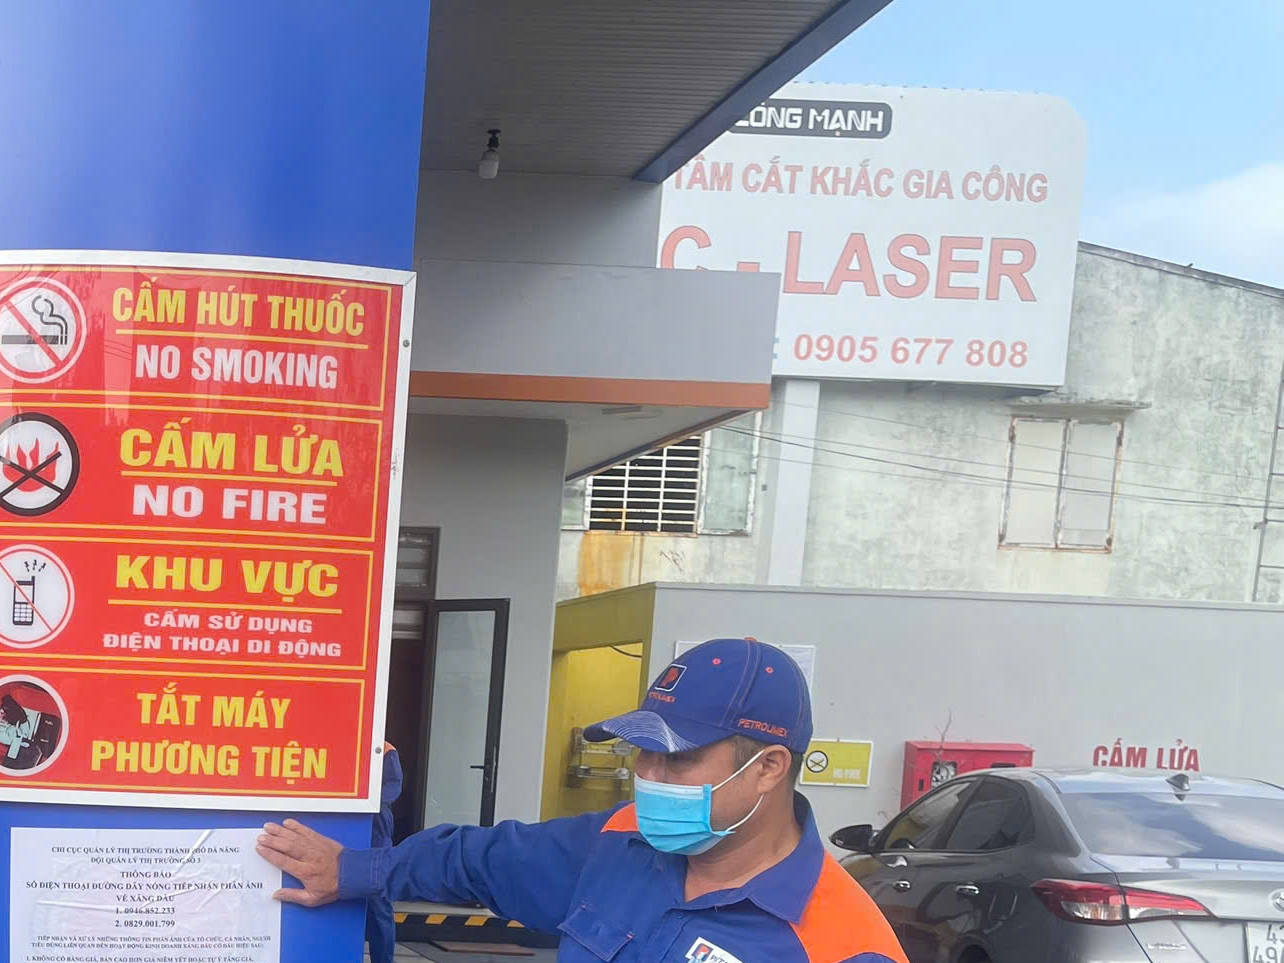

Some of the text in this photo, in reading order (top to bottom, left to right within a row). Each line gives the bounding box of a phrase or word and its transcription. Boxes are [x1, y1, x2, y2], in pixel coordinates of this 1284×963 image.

[741, 155, 804, 194] CẮT
[811, 158, 894, 197] KHẮC
[903, 169, 954, 200] GIA
[961, 165, 1049, 203] CÔNG
[783, 230, 1037, 302] LASER
[113, 277, 364, 337] CẤM HÚT THUỐC
[135, 344, 338, 390] NO SMOKING
[793, 333, 1028, 369] 0905 677 808
[119, 416, 344, 477] CẤM LỬA
[132, 484, 327, 524] NO FIRE
[116, 554, 339, 603] KHU VỰC
[143, 610, 312, 635] CẤM SỬ DỤNG
[103, 632, 341, 659] ĐIỆN THOẠI DI ĐỘNG
[137, 682, 291, 729] TẮT MÁY
[91, 739, 327, 784] PHƯƠNG TIỆN
[1093, 737, 1200, 772] CẤM LỬA
[124, 920, 176, 928] 0829.001.799
